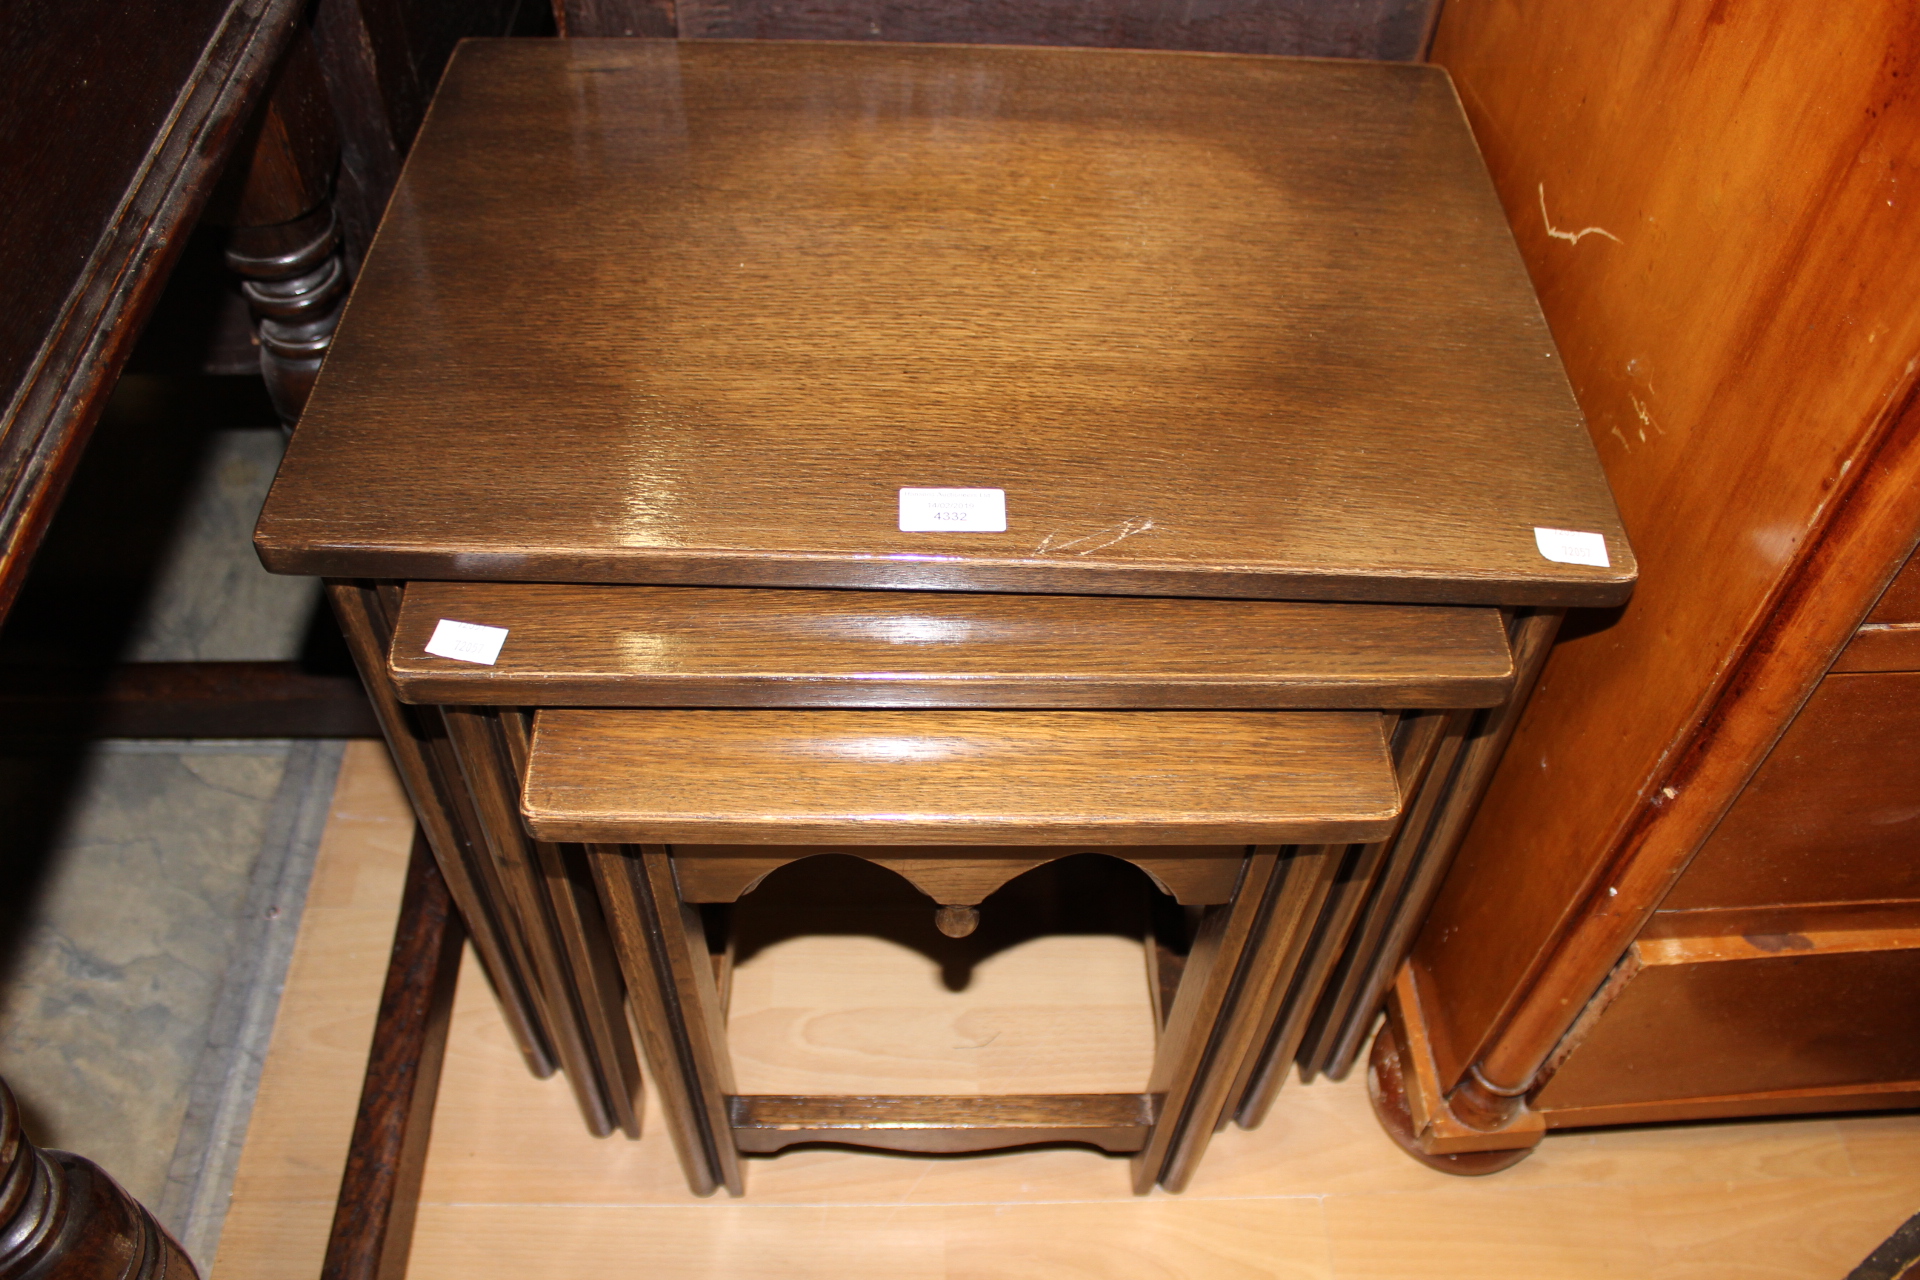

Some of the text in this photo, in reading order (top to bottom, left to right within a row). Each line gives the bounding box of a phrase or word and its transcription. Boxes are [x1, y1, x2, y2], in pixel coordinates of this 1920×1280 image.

[933, 511, 967, 521] 4332
[1561, 545, 1591, 558] 72057
[454, 639, 485, 654] 72057
